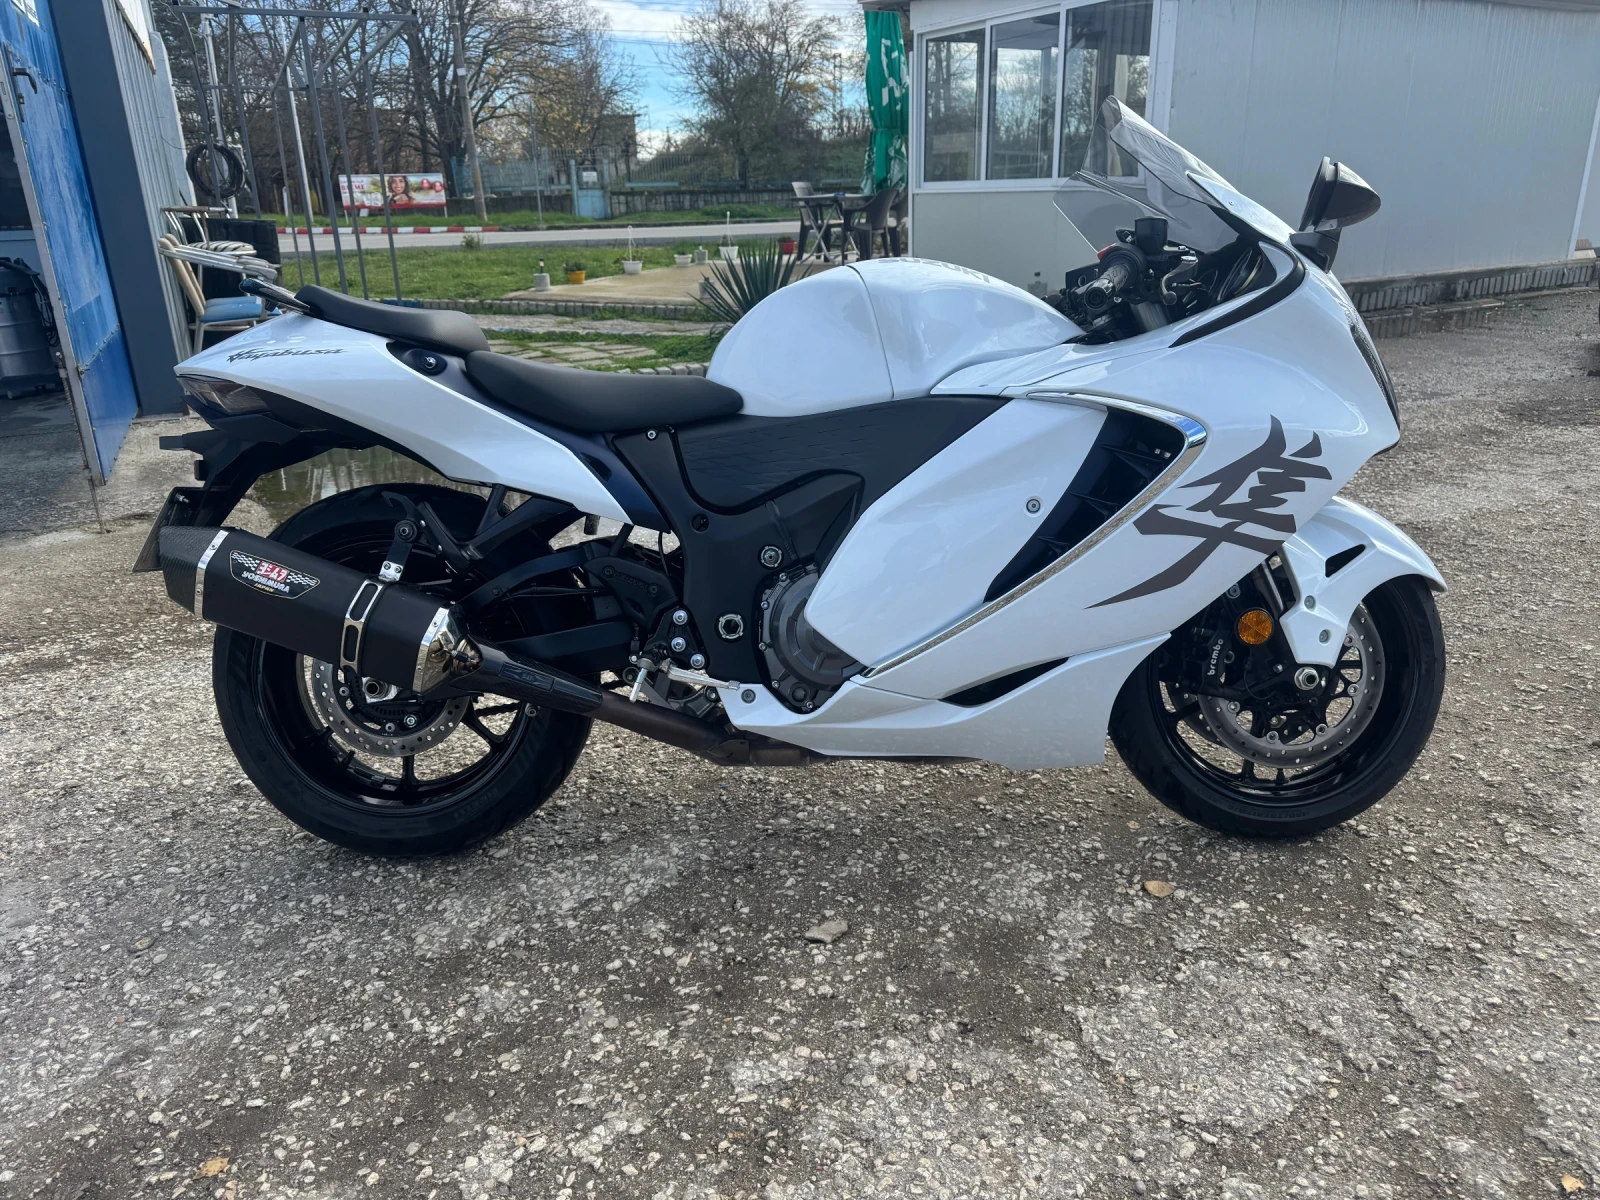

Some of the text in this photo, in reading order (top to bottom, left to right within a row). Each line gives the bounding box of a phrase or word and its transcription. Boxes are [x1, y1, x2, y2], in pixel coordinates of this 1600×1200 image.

[878, 258, 990, 283] SUZUKI
[226, 347, 348, 364] Hayabusa
[1083, 414, 1332, 610] 隼
[241, 570, 291, 593] YOSHIMURA
[254, 582, 275, 592] JAPAN
[1207, 638, 1223, 675] brembo
